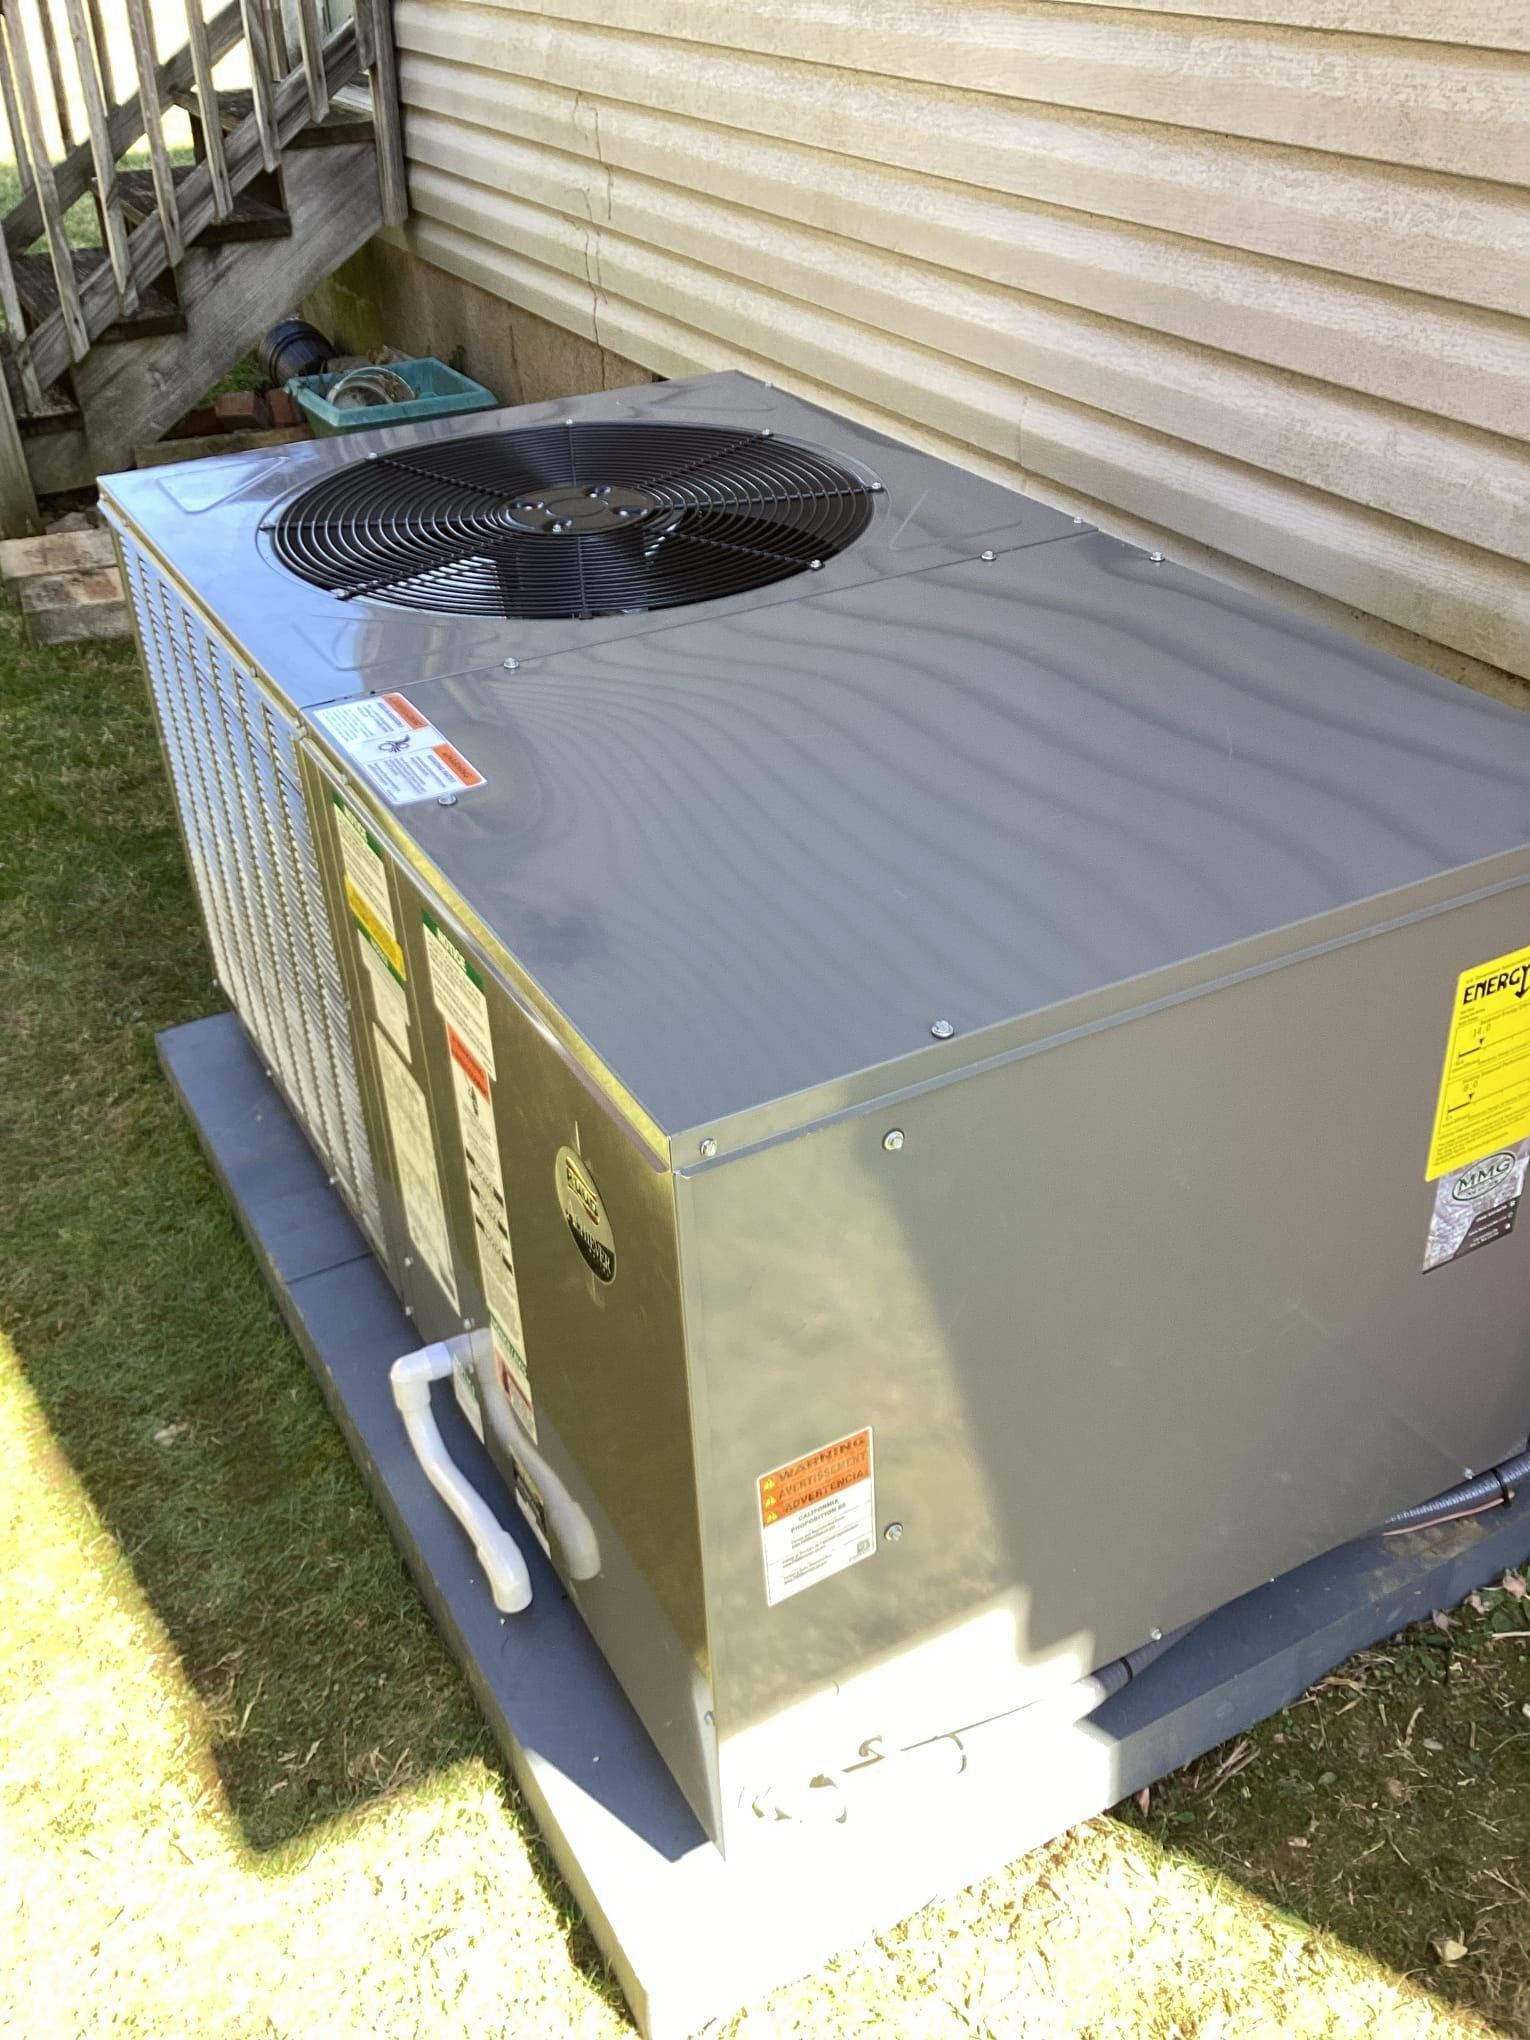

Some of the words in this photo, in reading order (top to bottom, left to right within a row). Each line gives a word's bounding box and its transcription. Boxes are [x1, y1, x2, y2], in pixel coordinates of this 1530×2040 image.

[1456, 1159, 1512, 1193] MMG
[778, 1436, 866, 1482] WARNING
[779, 1453, 867, 1499] AVERTISSEMENT
[785, 1469, 865, 1512] ADVERTENCIA
